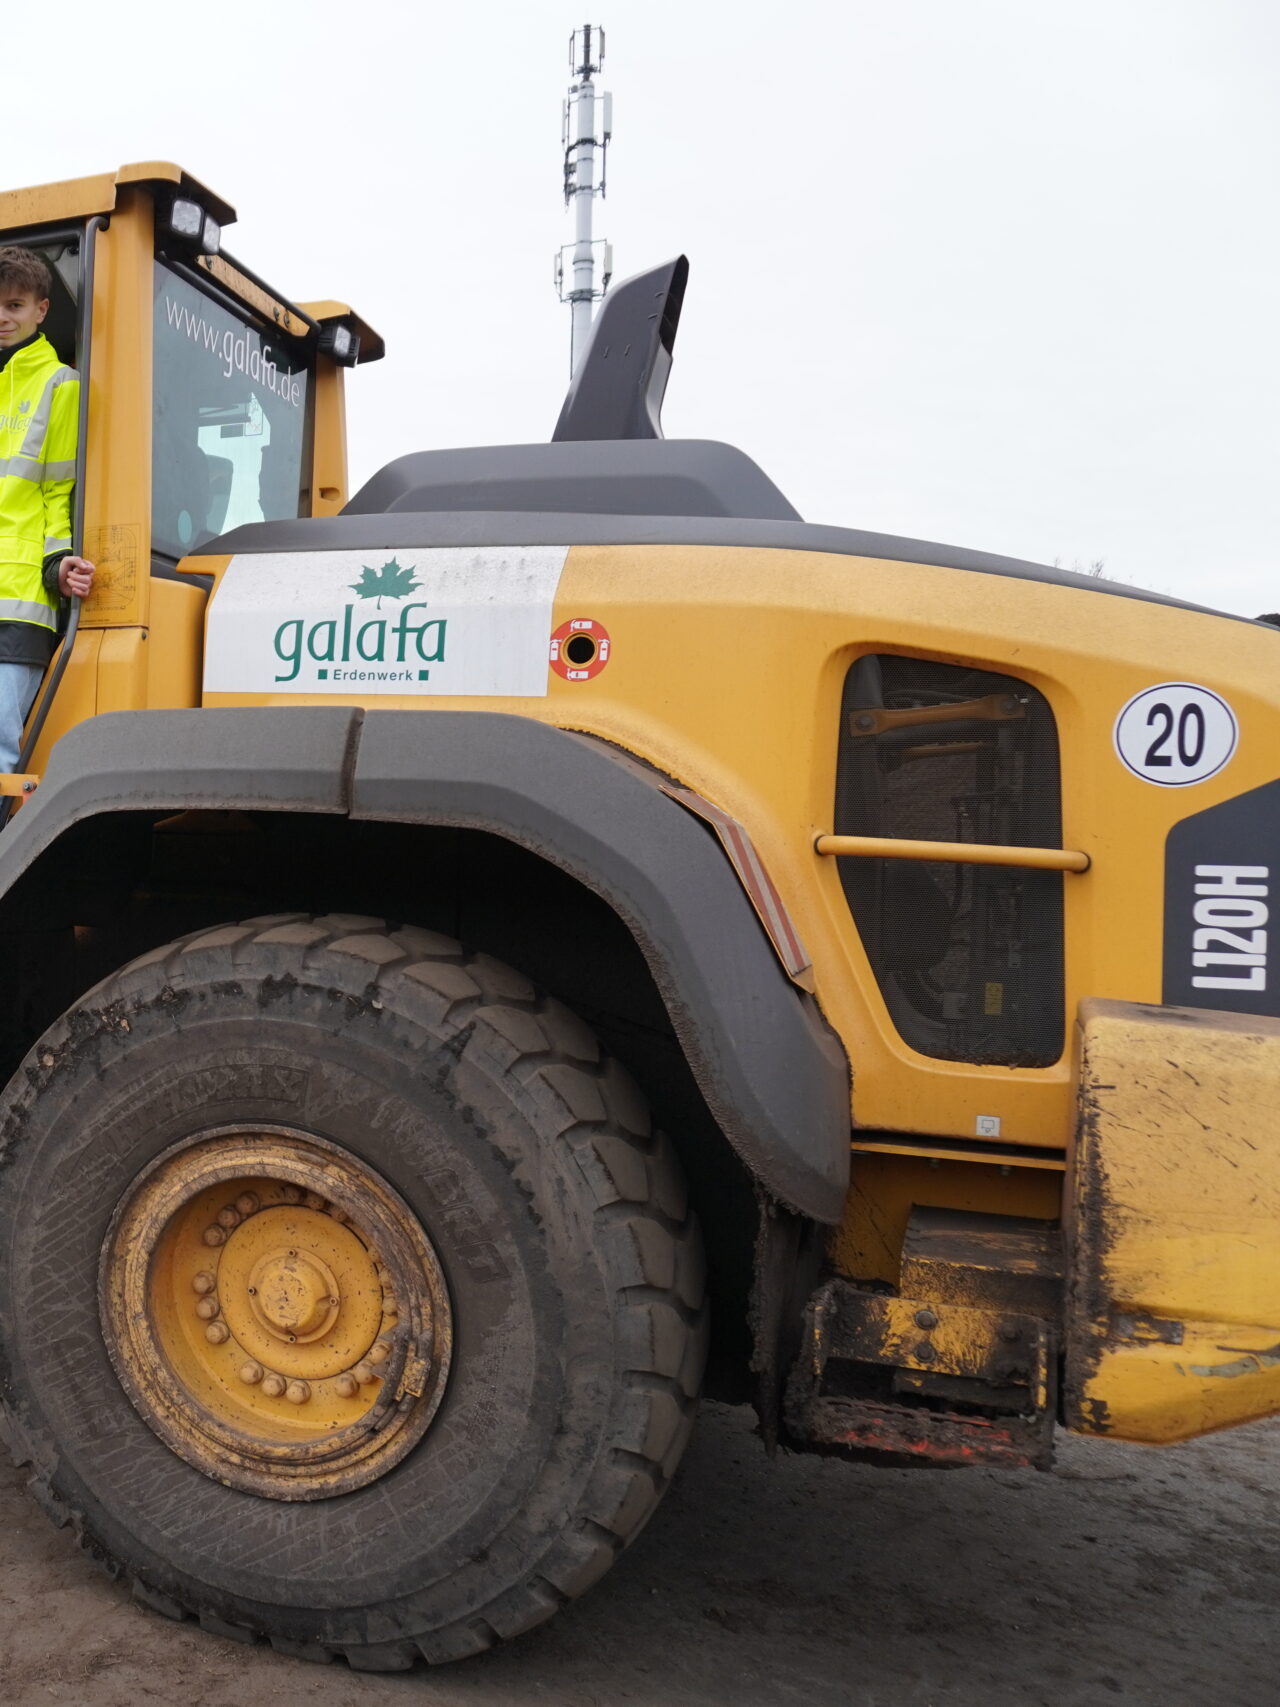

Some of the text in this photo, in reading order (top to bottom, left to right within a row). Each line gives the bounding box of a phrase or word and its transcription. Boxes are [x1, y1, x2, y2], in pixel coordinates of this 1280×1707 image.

[166, 295, 301, 407] www.galafa.de
[273, 602, 448, 682] galafa
[333, 669, 414, 681] Erdenwerk
[1144, 702, 1206, 767] 20
[1192, 864, 1269, 991] L120H
